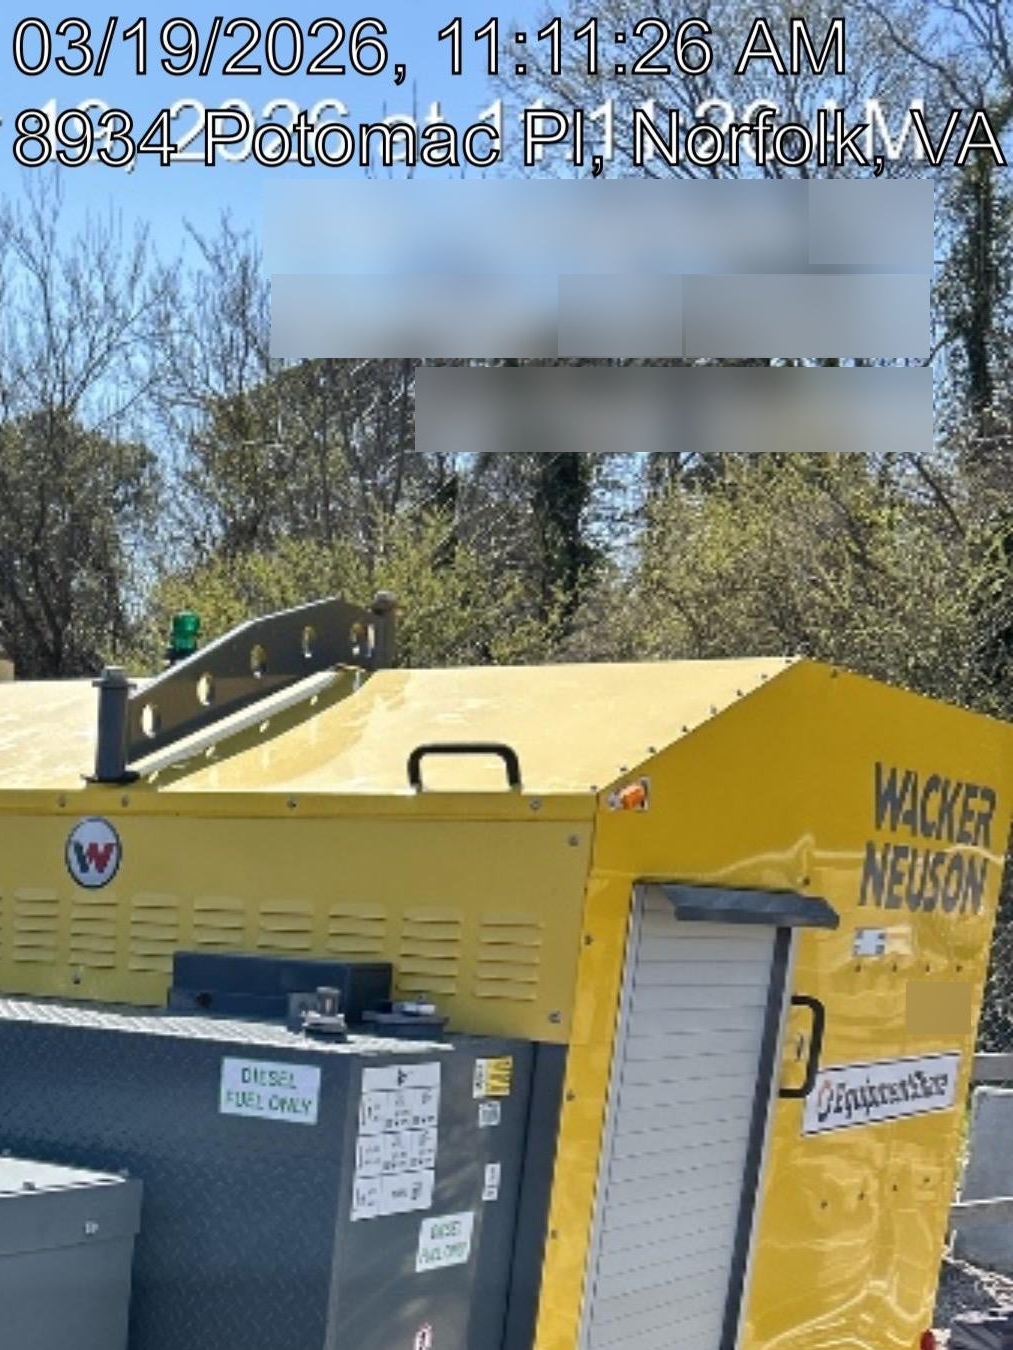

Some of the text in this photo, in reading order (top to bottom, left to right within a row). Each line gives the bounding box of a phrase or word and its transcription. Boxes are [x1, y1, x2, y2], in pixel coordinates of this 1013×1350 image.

[874, 761, 997, 848] WACKER
[857, 841, 988, 915] NEUSON
[241, 1066, 297, 1090] DIESEL
